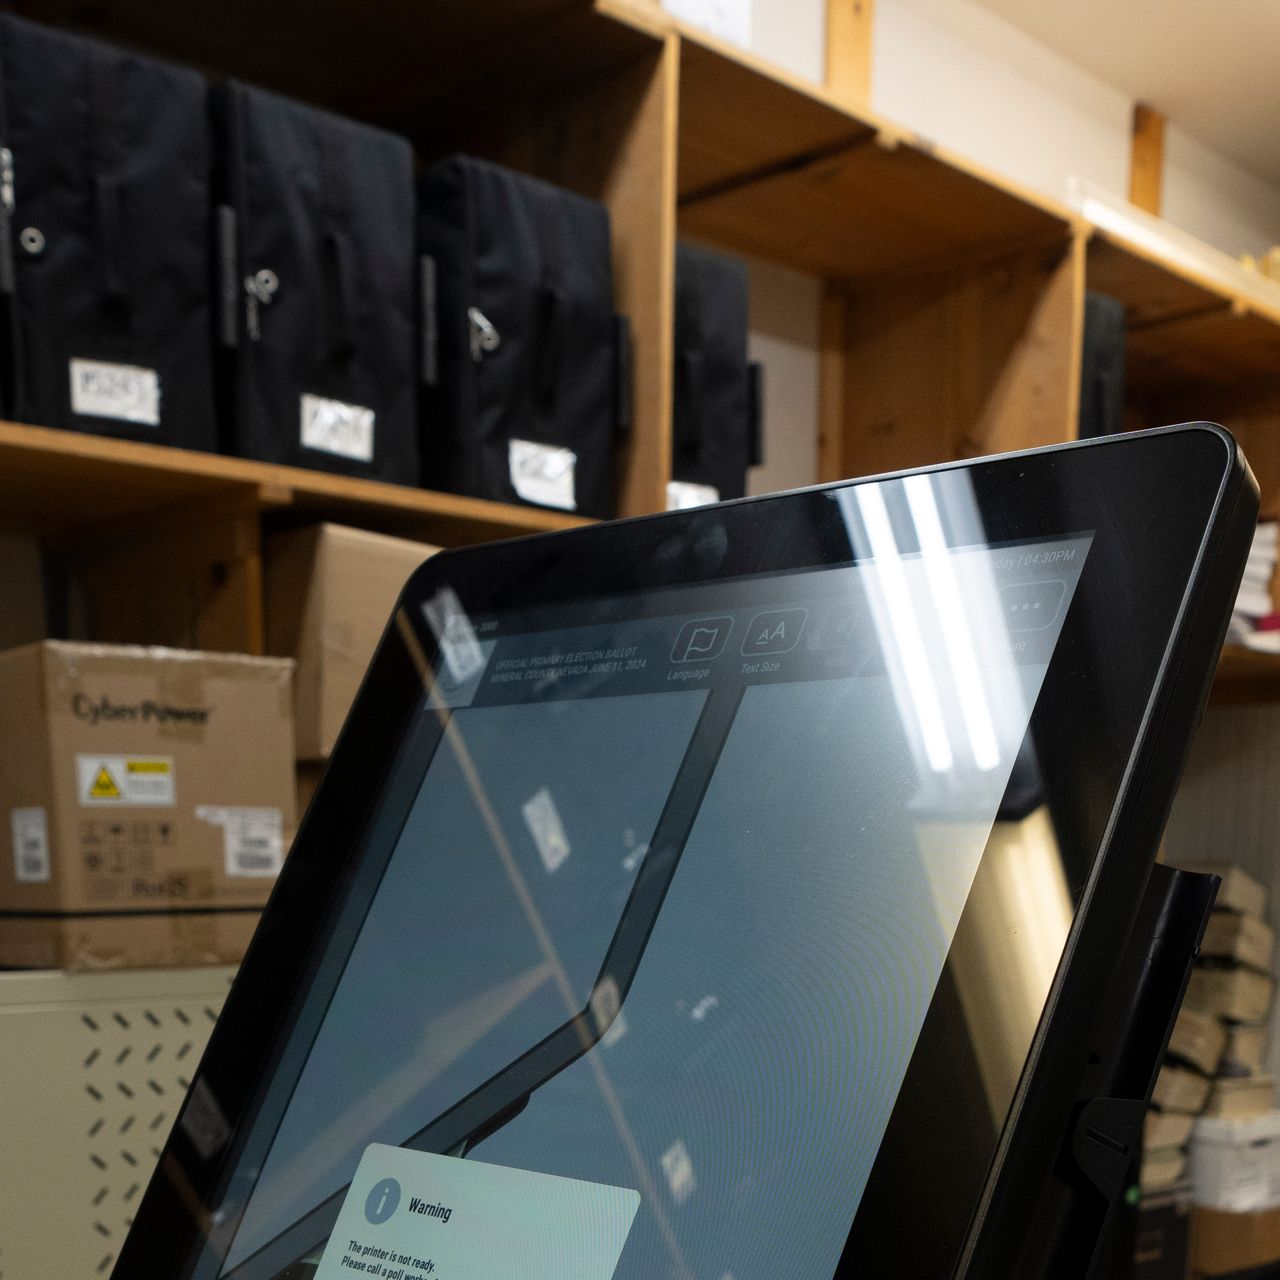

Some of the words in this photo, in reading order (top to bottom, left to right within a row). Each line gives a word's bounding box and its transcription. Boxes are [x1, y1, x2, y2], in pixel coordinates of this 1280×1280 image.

[1023, 549, 1076, 567] 04:30PM
[495, 658, 528, 671] OFFICIAL
[529, 654, 564, 668] PRIMARY
[564, 649, 604, 664] ELECTION
[604, 646, 639, 660] BALLOT
[588, 661, 612, 675] JUNE
[624, 658, 648, 671] 2024
[741, 663, 761, 674] Text
[761, 661, 782, 674] Size
[667, 668, 711, 682] Language
[408, 1197, 453, 1225] Warning
[341, 1256, 366, 1272] Please
[367, 1263, 381, 1277] call
[348, 1240, 362, 1254] The
[362, 1245, 389, 1262] printer
[389, 1249, 397, 1264] is
[398, 1253, 411, 1267] not
[411, 1256, 435, 1274] ready.
